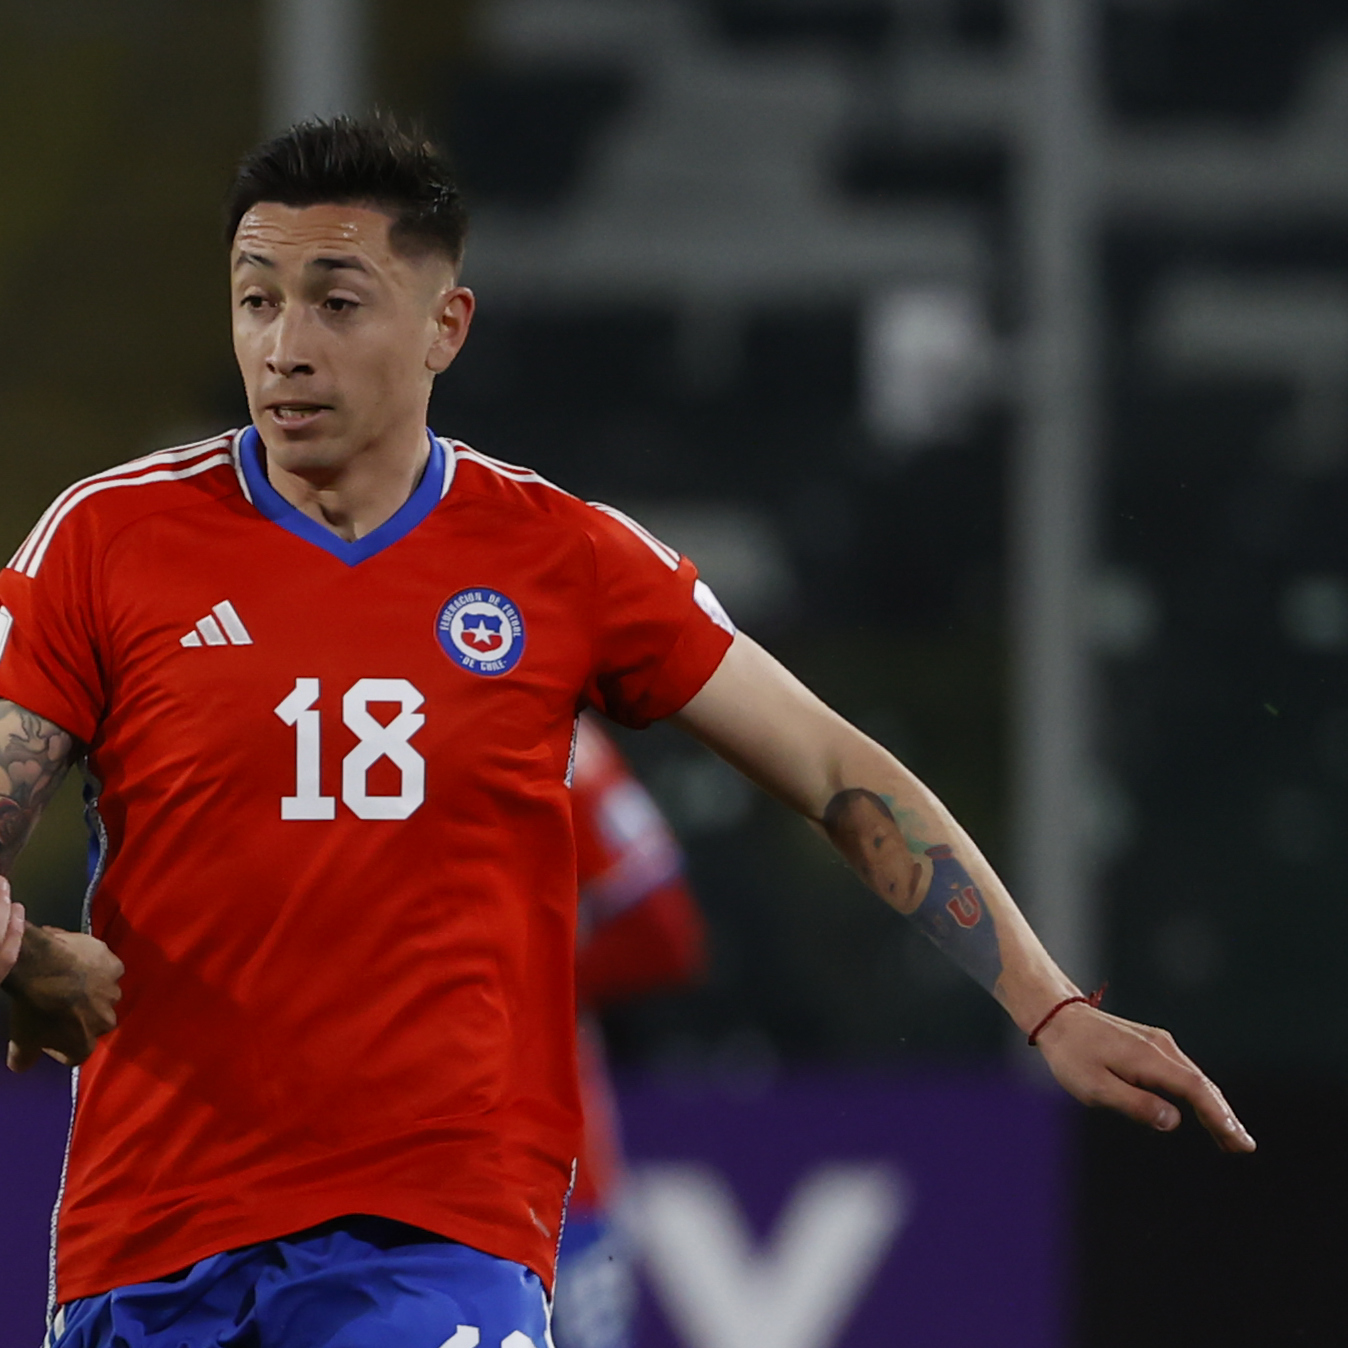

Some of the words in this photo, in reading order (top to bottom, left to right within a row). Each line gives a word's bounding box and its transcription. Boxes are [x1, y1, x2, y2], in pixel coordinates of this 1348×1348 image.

[439, 592, 482, 631] FEDERACION
[488, 593, 501, 606] DE
[502, 603, 521, 637] FUTBOL
[273, 677, 426, 820] 18
